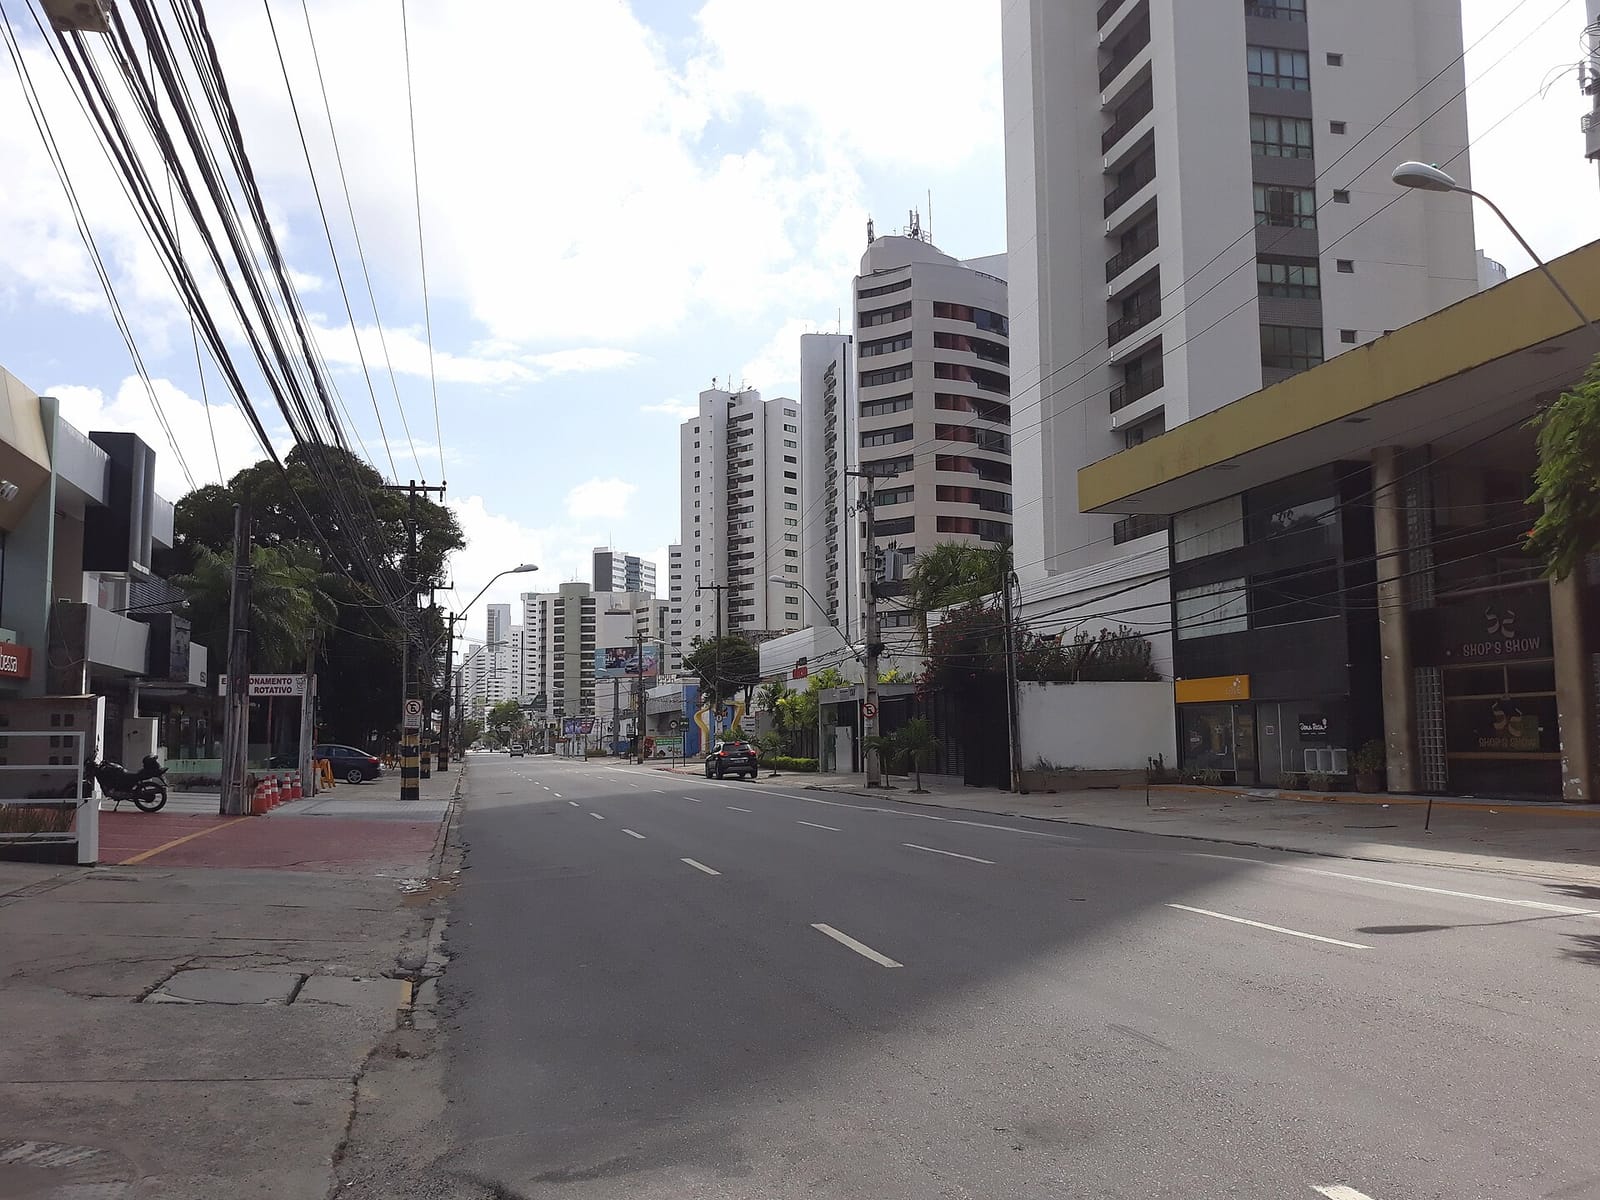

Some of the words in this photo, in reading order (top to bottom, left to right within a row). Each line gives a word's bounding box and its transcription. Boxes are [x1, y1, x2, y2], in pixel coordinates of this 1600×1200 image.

[1463, 641, 1502, 657] SHOP'S
[1505, 636, 1540, 653] SHOW
[254, 686, 293, 694] ROTATIVO
